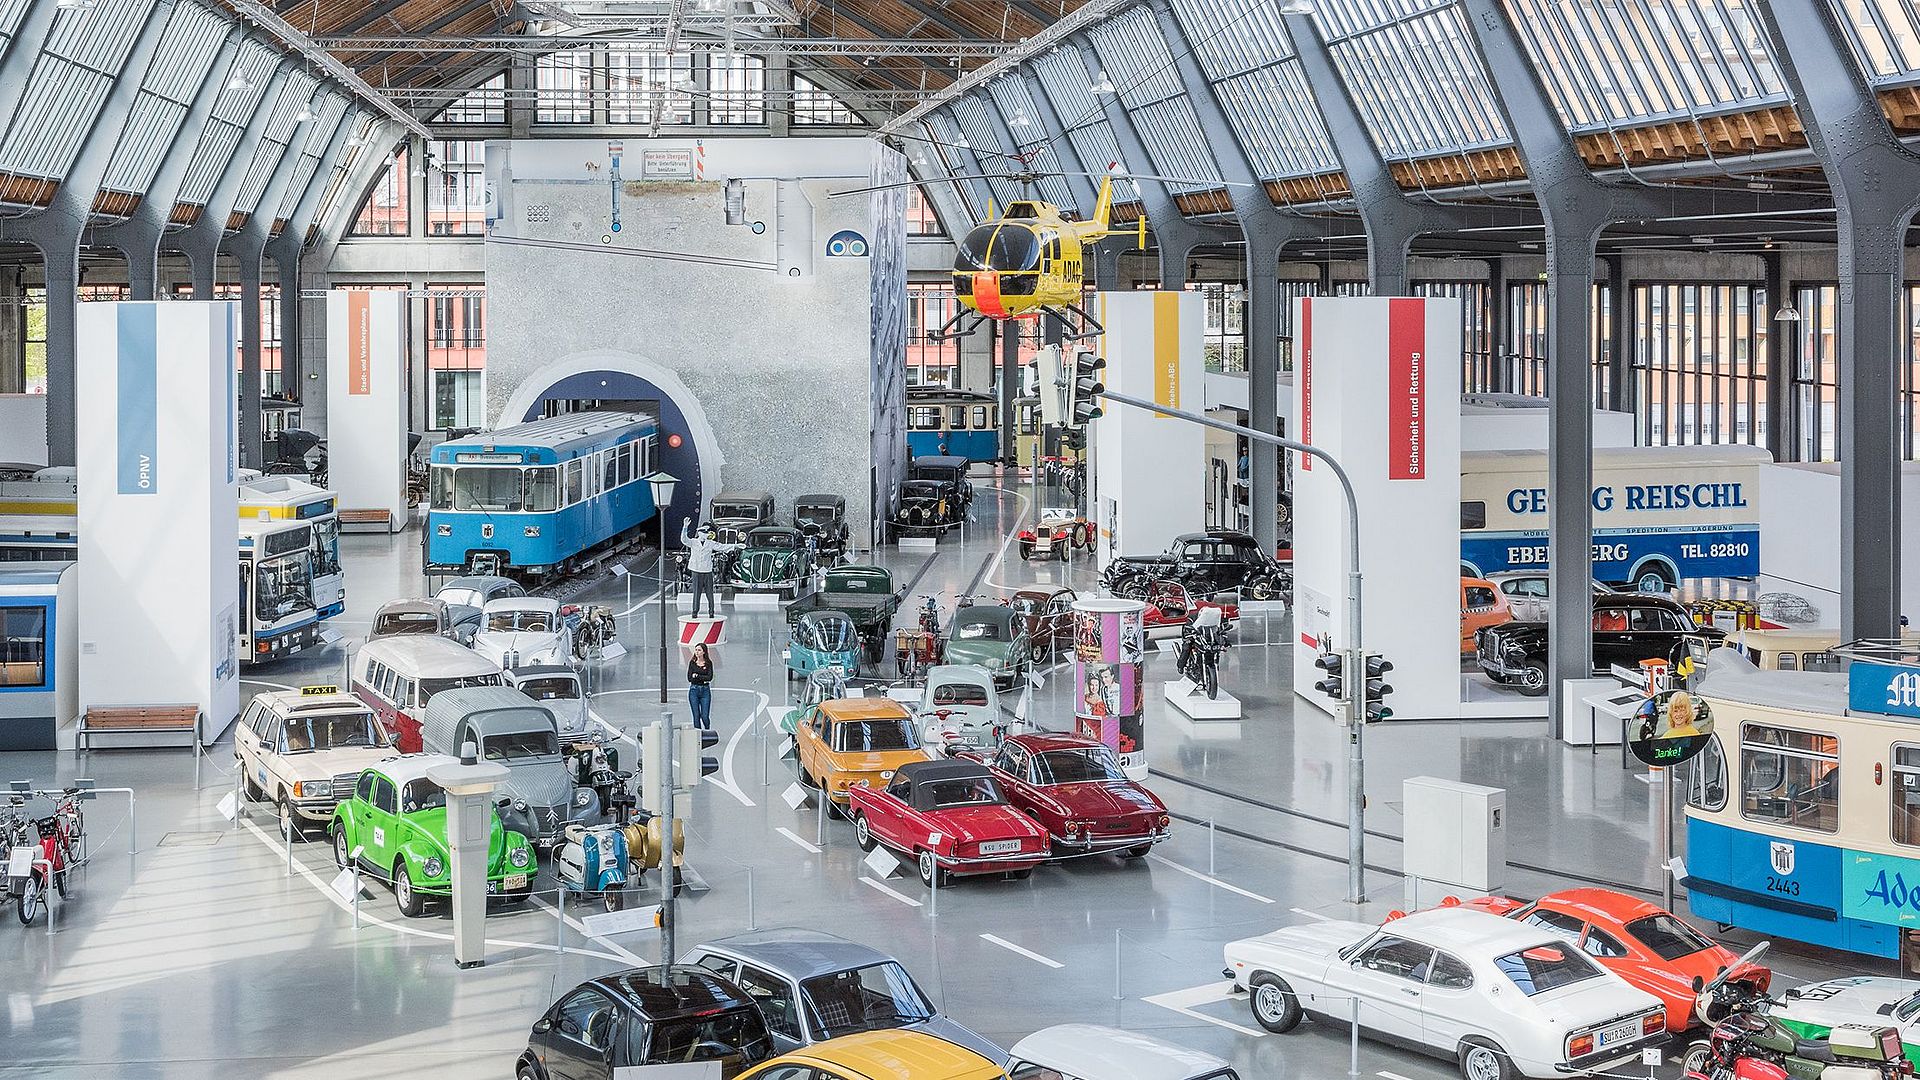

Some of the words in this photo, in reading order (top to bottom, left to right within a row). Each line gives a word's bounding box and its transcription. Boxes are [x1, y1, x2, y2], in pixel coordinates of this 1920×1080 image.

[1409, 352, 1421, 394] Rettung
[1409, 397, 1419, 417] und
[1409, 420, 1419, 474] Sicherheit
[138, 454, 150, 489] ÖPNV
[1507, 487, 1614, 513] GEG
[1625, 483, 1747, 510] REISCHL
[1680, 544, 1708, 559] TEL.
[1710, 543, 1749, 557] 82810
[1654, 746, 1682, 759] Danke!
[998, 842, 1017, 850] SPIDER
[1766, 876, 1800, 897] 2443
